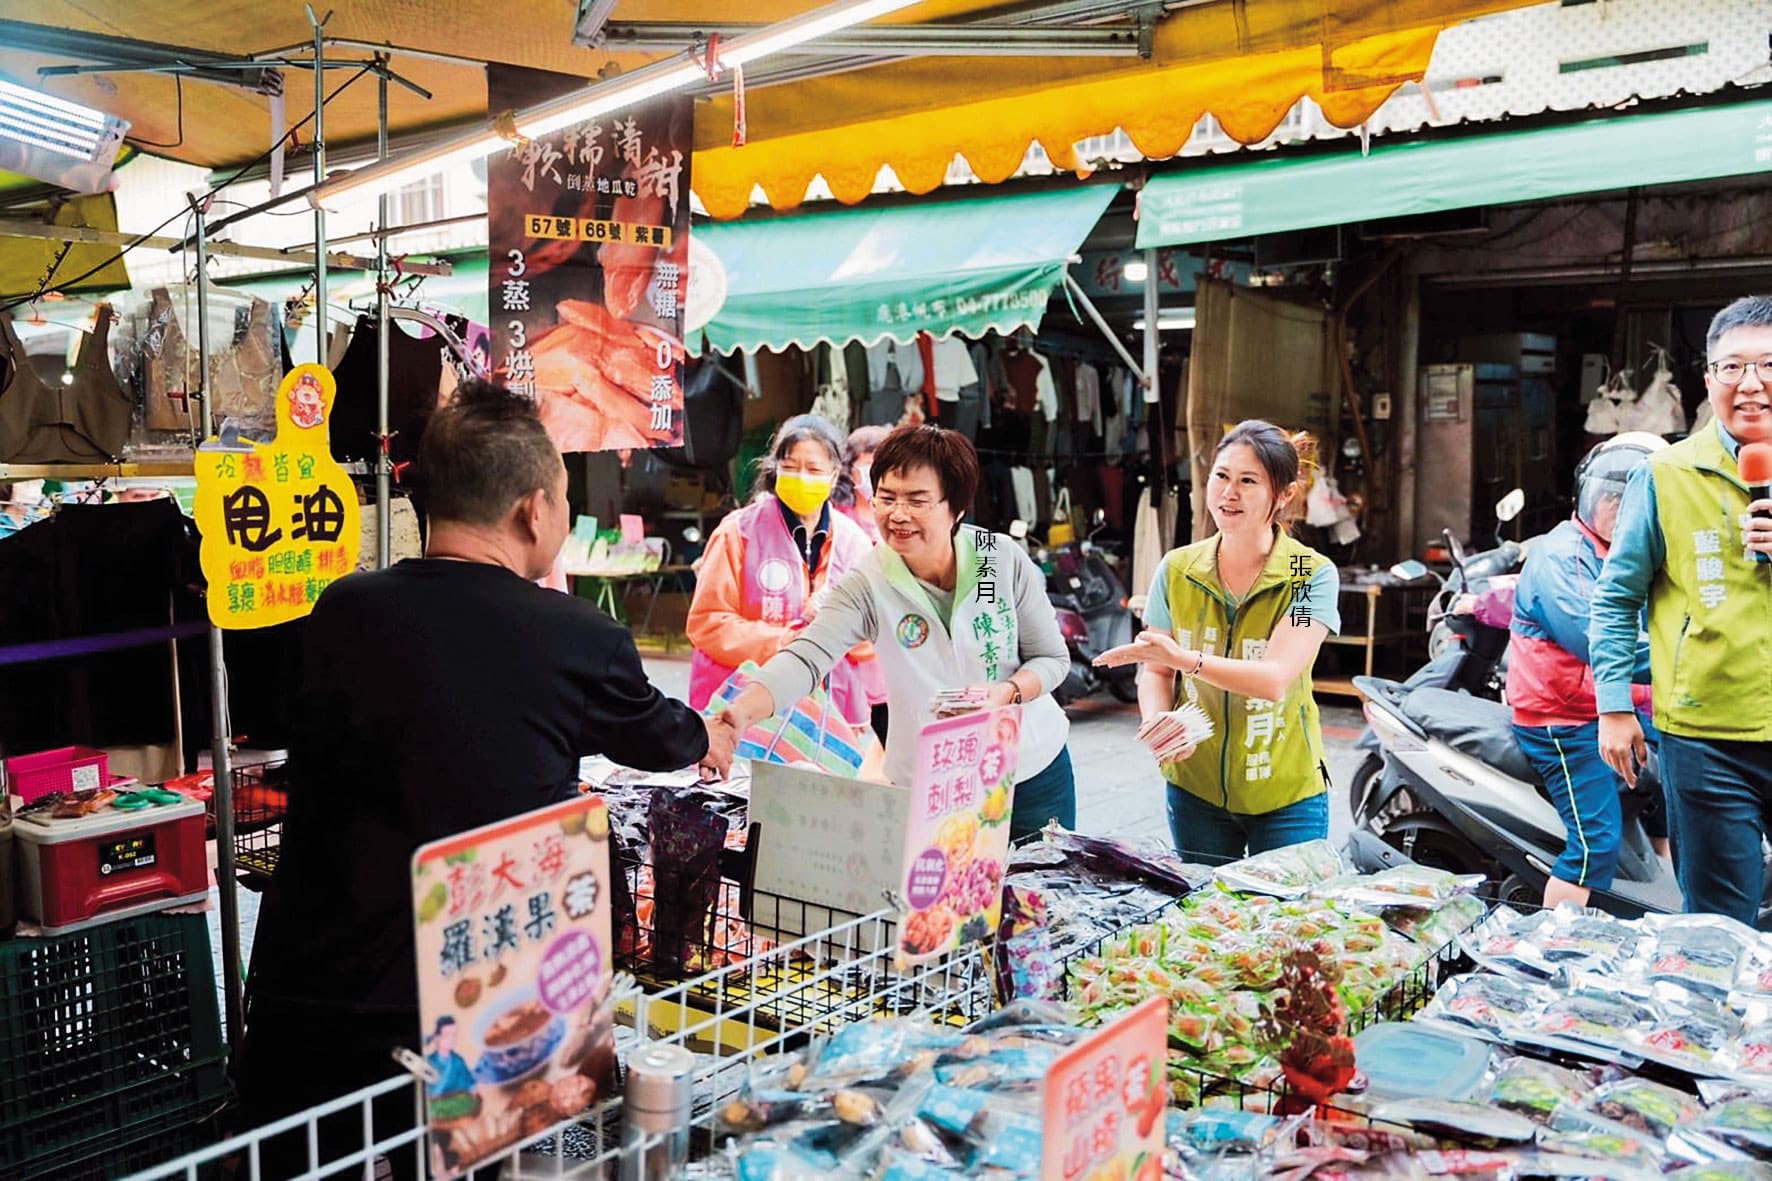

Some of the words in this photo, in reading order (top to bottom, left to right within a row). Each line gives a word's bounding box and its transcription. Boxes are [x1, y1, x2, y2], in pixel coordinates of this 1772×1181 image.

[531, 217, 571, 237] 57號
[585, 222, 621, 241] 66號
[223, 484, 345, 552] 甩油
[972, 611, 1000, 682] 陳素月
[441, 891, 557, 977] 羅漢果
